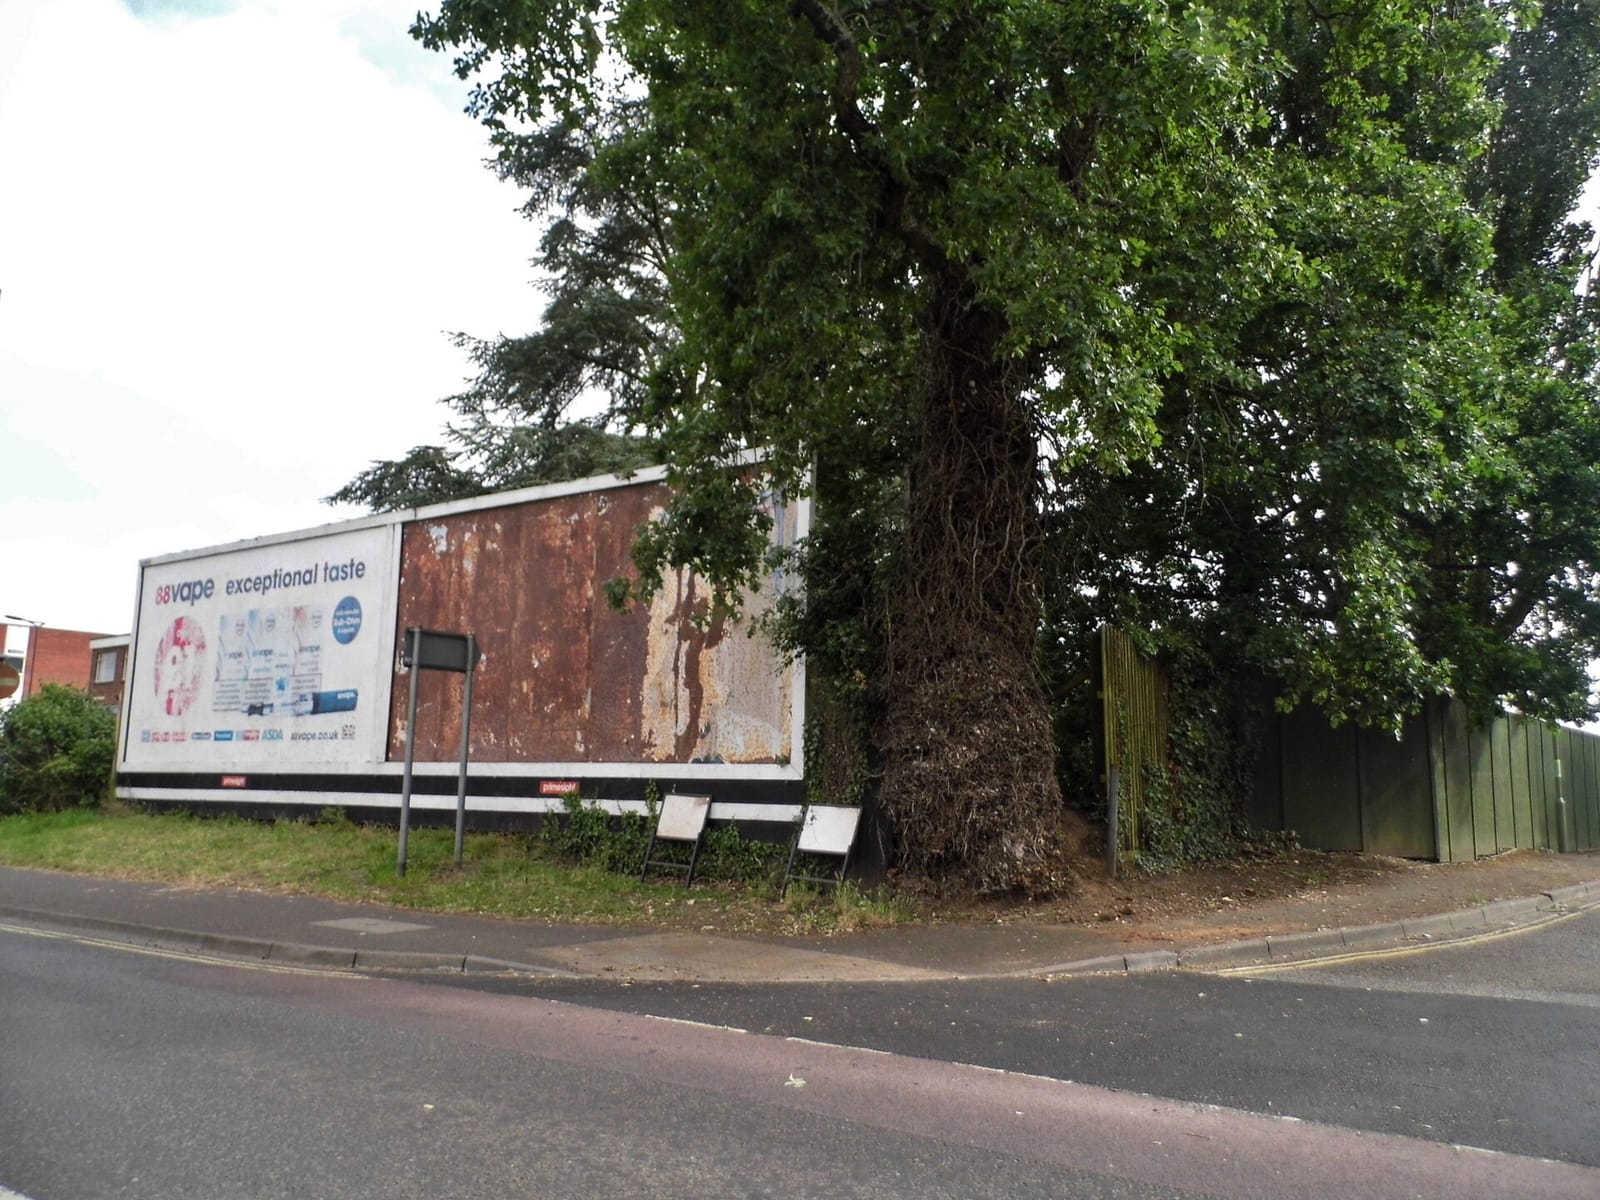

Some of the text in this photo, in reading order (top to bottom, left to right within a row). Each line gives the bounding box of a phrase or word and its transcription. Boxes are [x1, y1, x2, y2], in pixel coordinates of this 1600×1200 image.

[225, 558, 366, 595] exceptional taste
[155, 578, 215, 606] 88vape
[262, 729, 283, 741] ASDA
